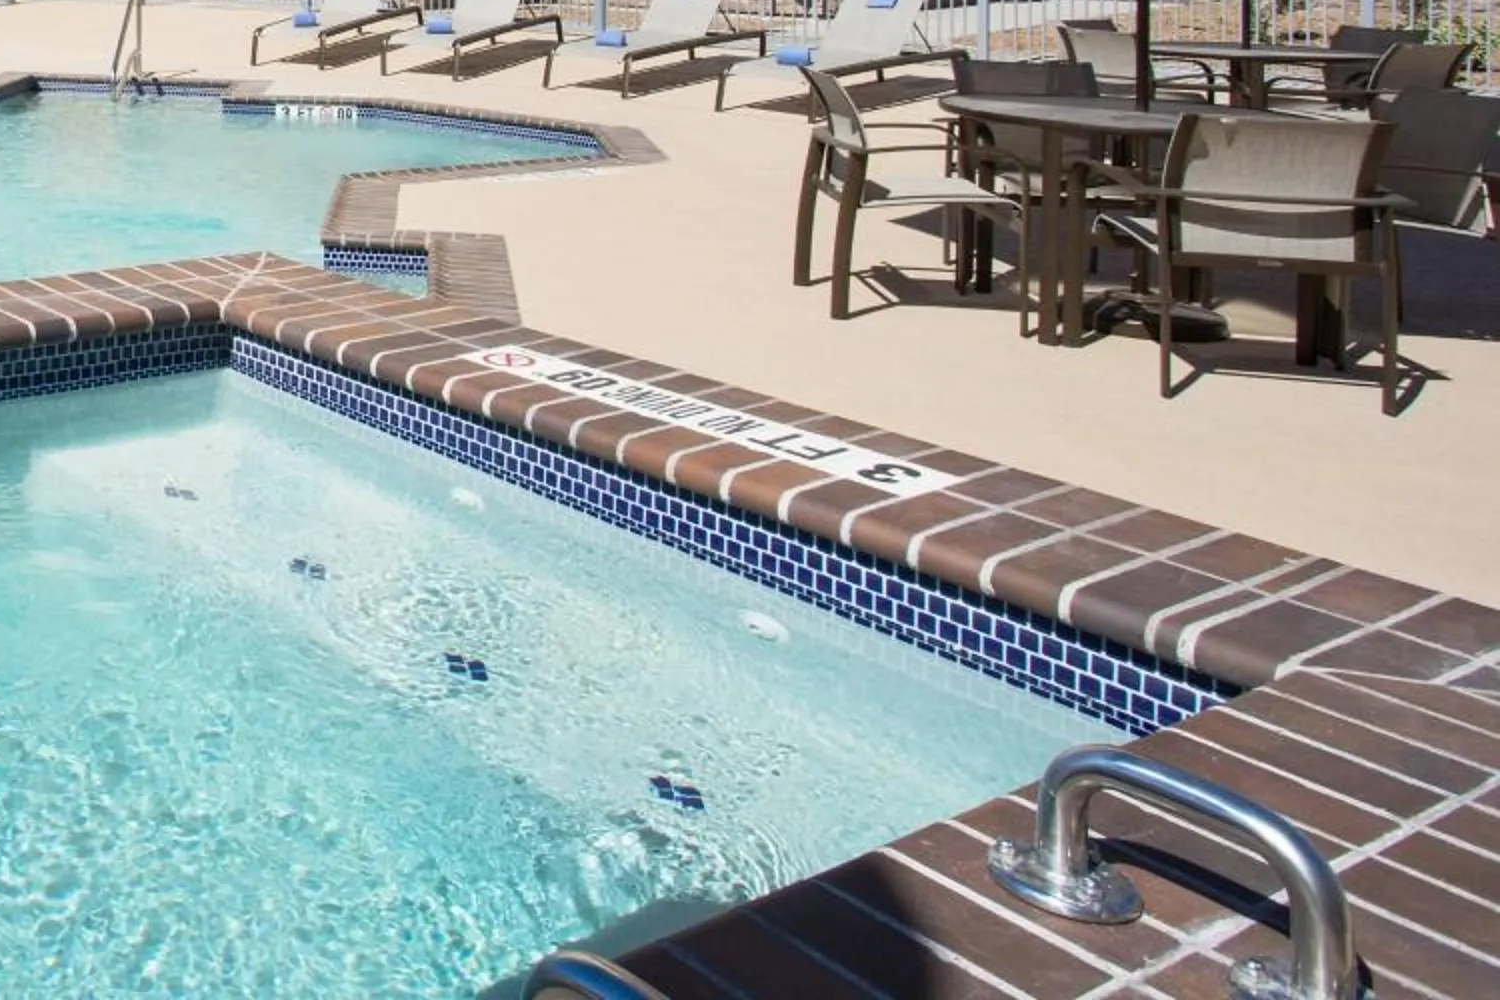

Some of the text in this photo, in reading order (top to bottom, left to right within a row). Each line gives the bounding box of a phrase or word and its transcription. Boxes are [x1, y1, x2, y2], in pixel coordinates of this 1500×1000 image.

[698, 415, 764, 435] NO
[747, 433, 849, 461] FT
[857, 463, 922, 483] 3
